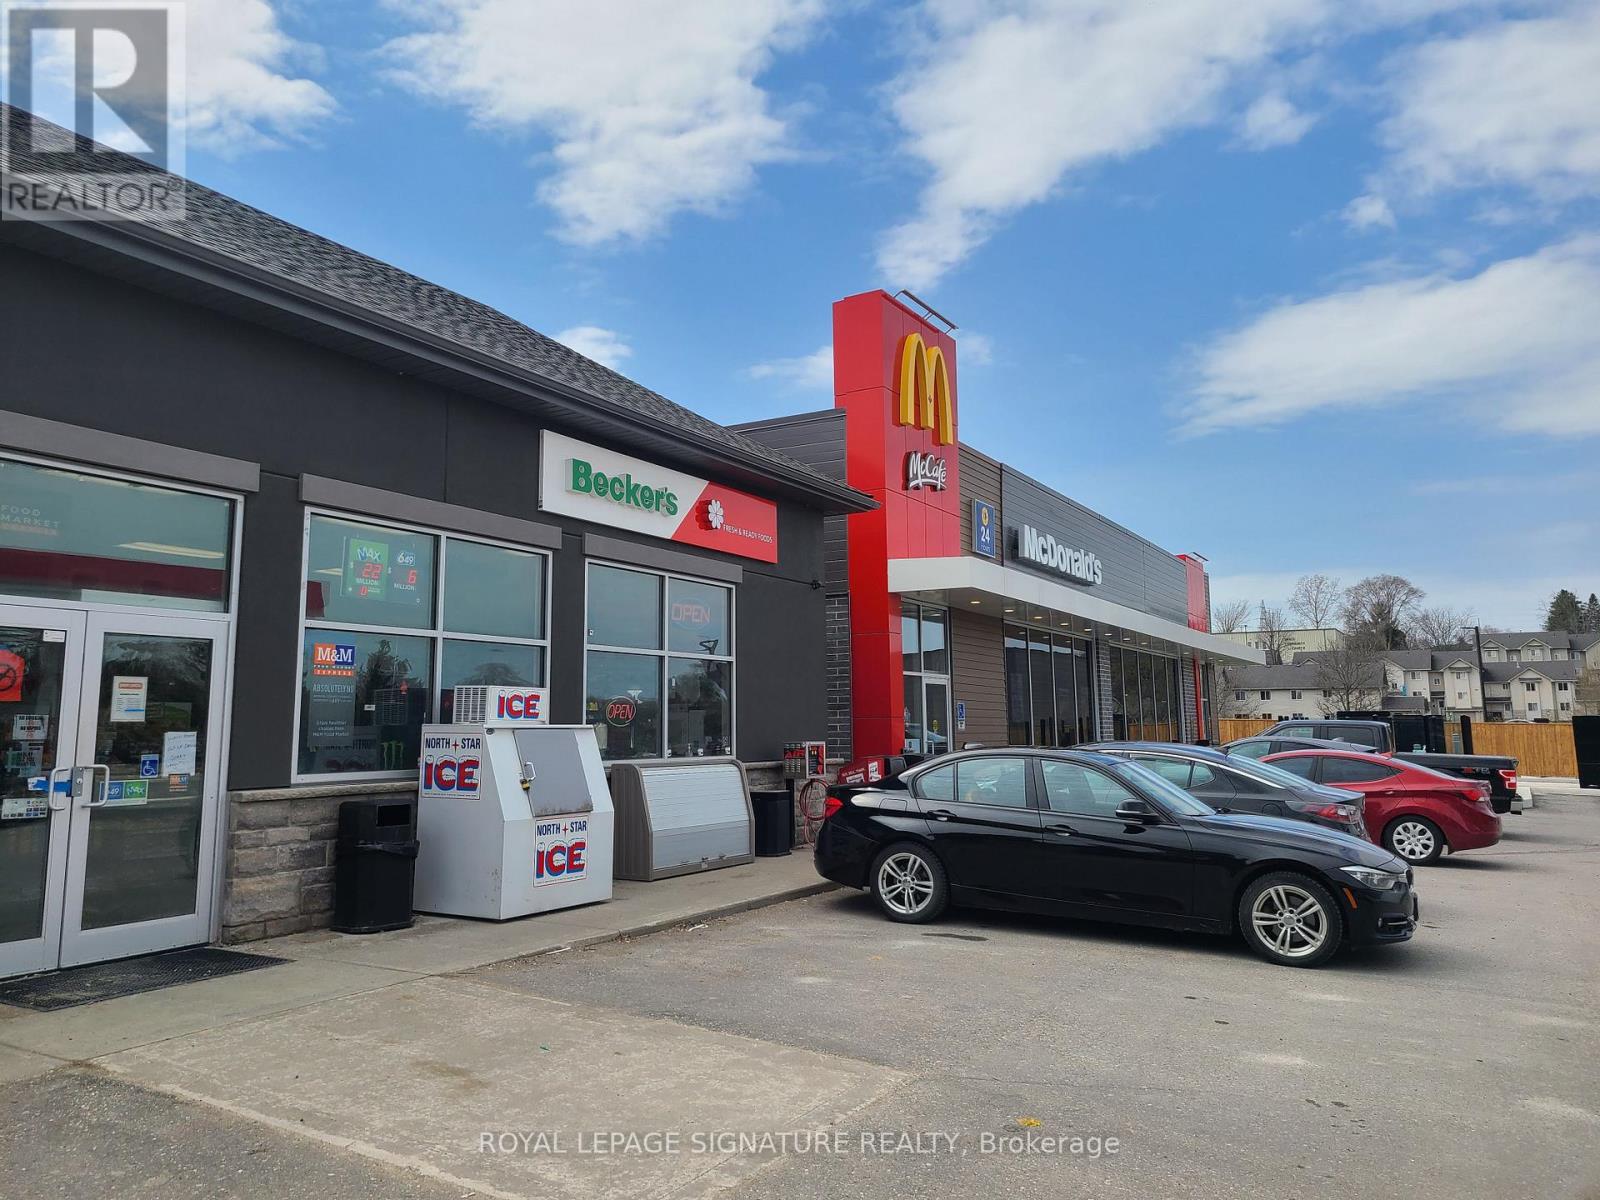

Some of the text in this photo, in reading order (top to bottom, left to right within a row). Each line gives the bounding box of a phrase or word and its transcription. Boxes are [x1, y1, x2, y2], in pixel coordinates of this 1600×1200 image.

[571, 458, 679, 517] Becker's
[980, 526, 991, 544] 24
[1021, 525, 1103, 585] McDonald's
[362, 563, 383, 580] 22
[671, 603, 710, 624] OPEN
[318, 647, 352, 663] M&M
[607, 702, 634, 721] OPEN
[425, 737, 481, 750] NORTH STAR
[536, 820, 588, 836] NORTH STAR
